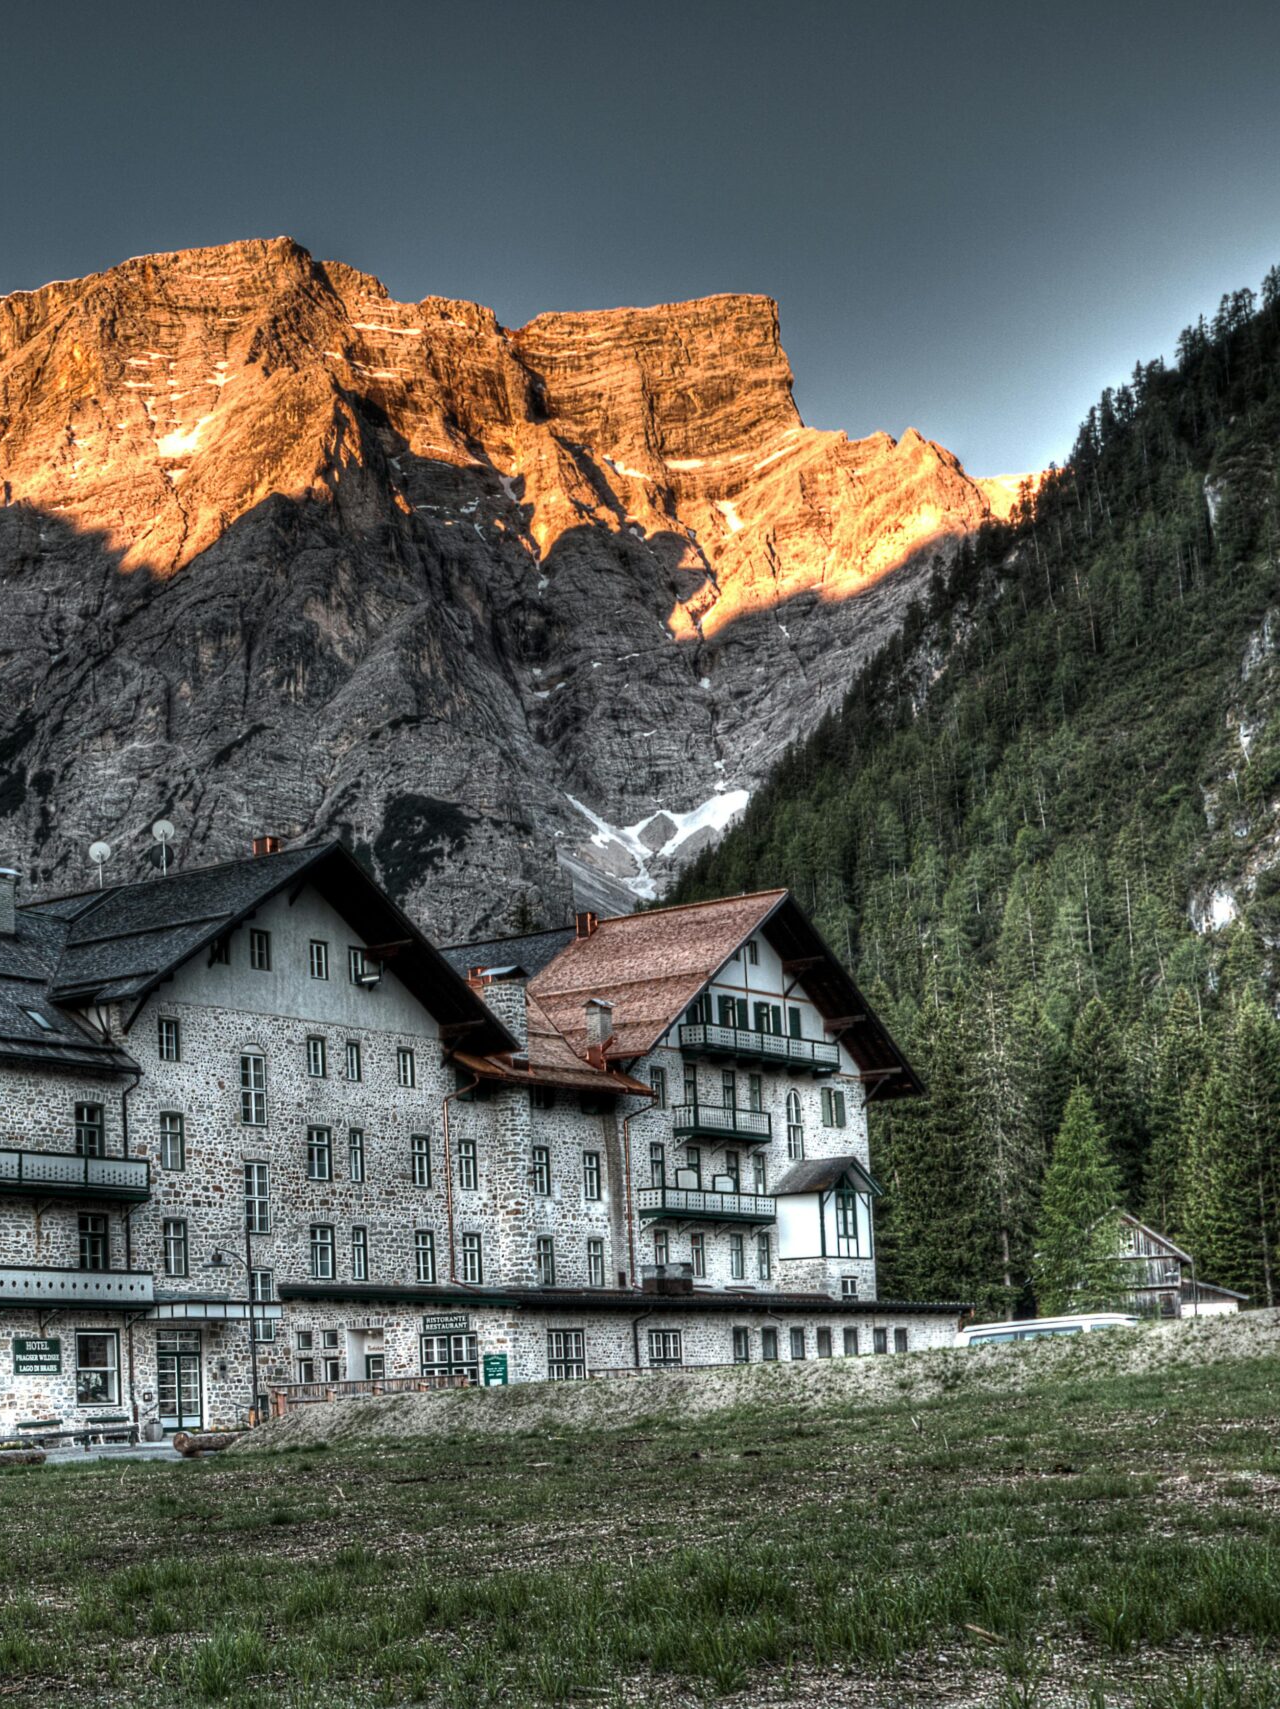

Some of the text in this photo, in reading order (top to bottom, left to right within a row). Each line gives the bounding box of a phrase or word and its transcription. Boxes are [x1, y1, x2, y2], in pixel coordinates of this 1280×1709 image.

[426, 1315, 467, 1323] RISTORANTE
[425, 1322, 468, 1330] RESTAURANT
[25, 1341, 50, 1350] HOTEL
